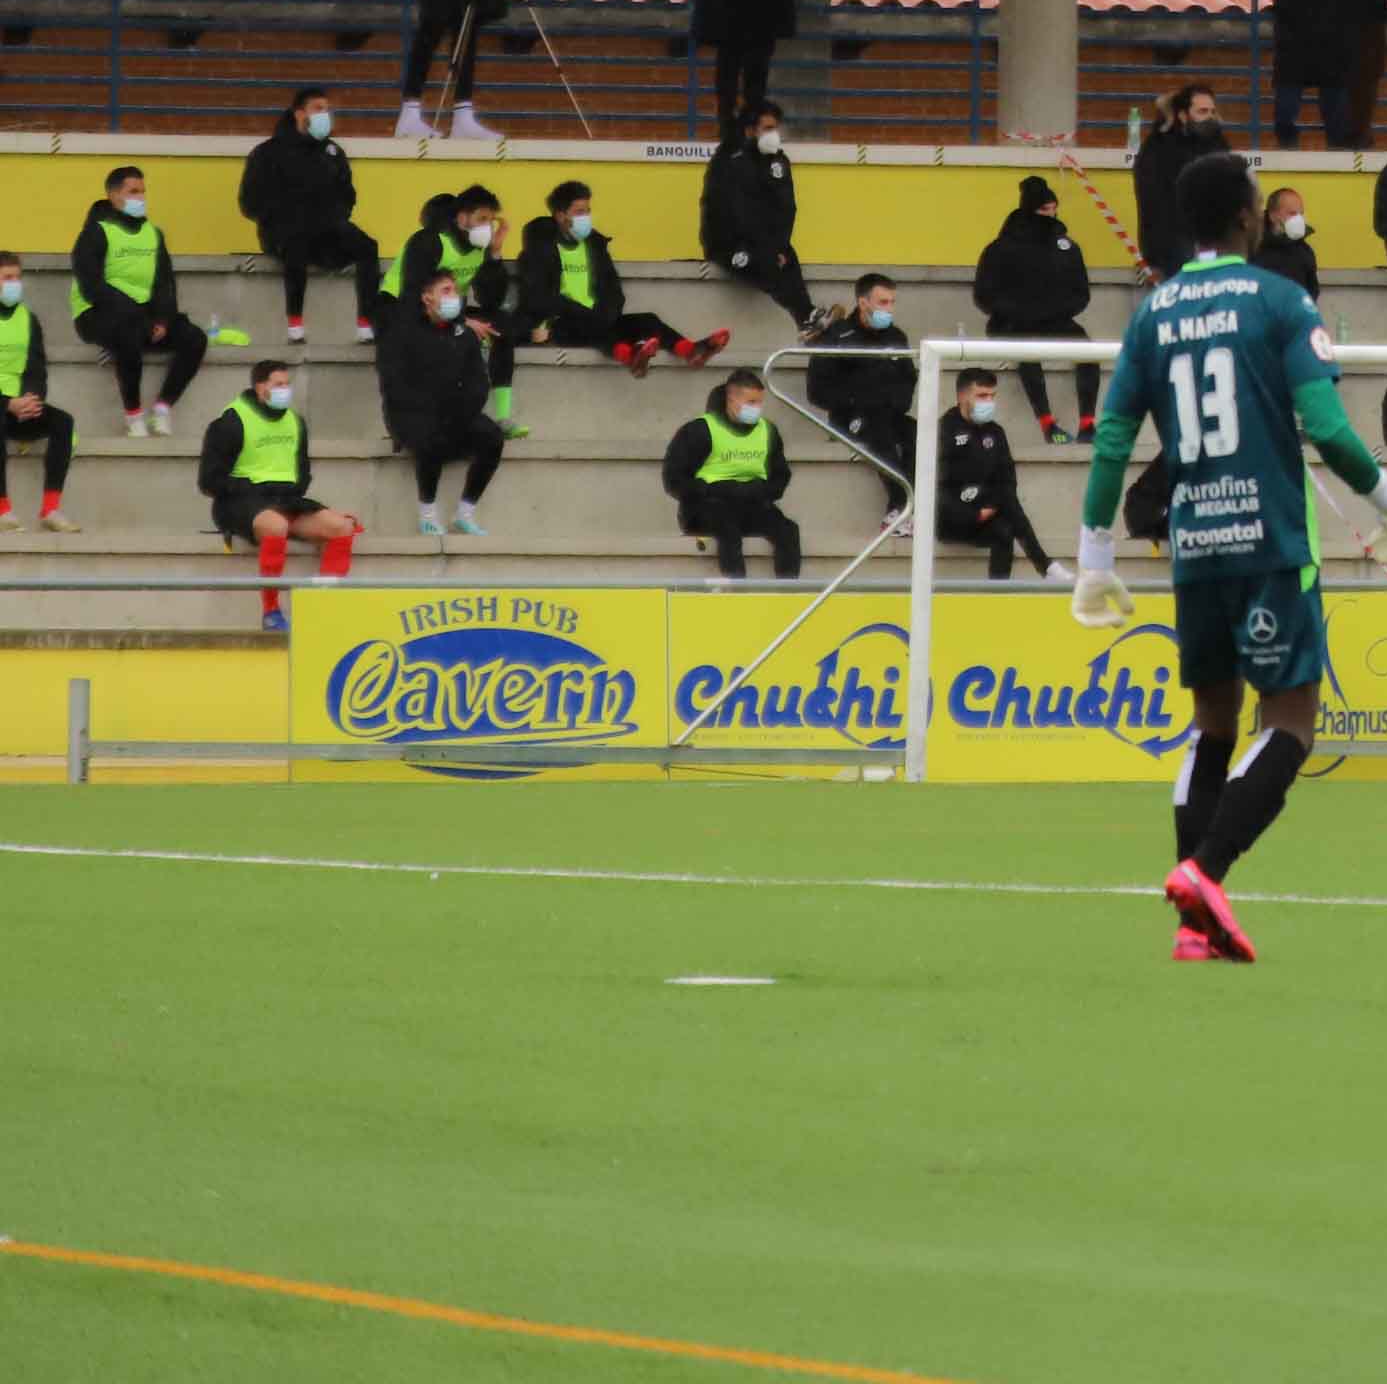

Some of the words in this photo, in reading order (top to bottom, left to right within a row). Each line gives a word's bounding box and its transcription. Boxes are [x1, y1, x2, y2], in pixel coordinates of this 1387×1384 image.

[1169, 346, 1240, 465] 13
[398, 595, 498, 636] IRISH
[511, 597, 579, 635] PUB
[326, 638, 638, 738] Cavern
[675, 664, 904, 728] Chuchi
[949, 664, 1173, 728] Chuchi
